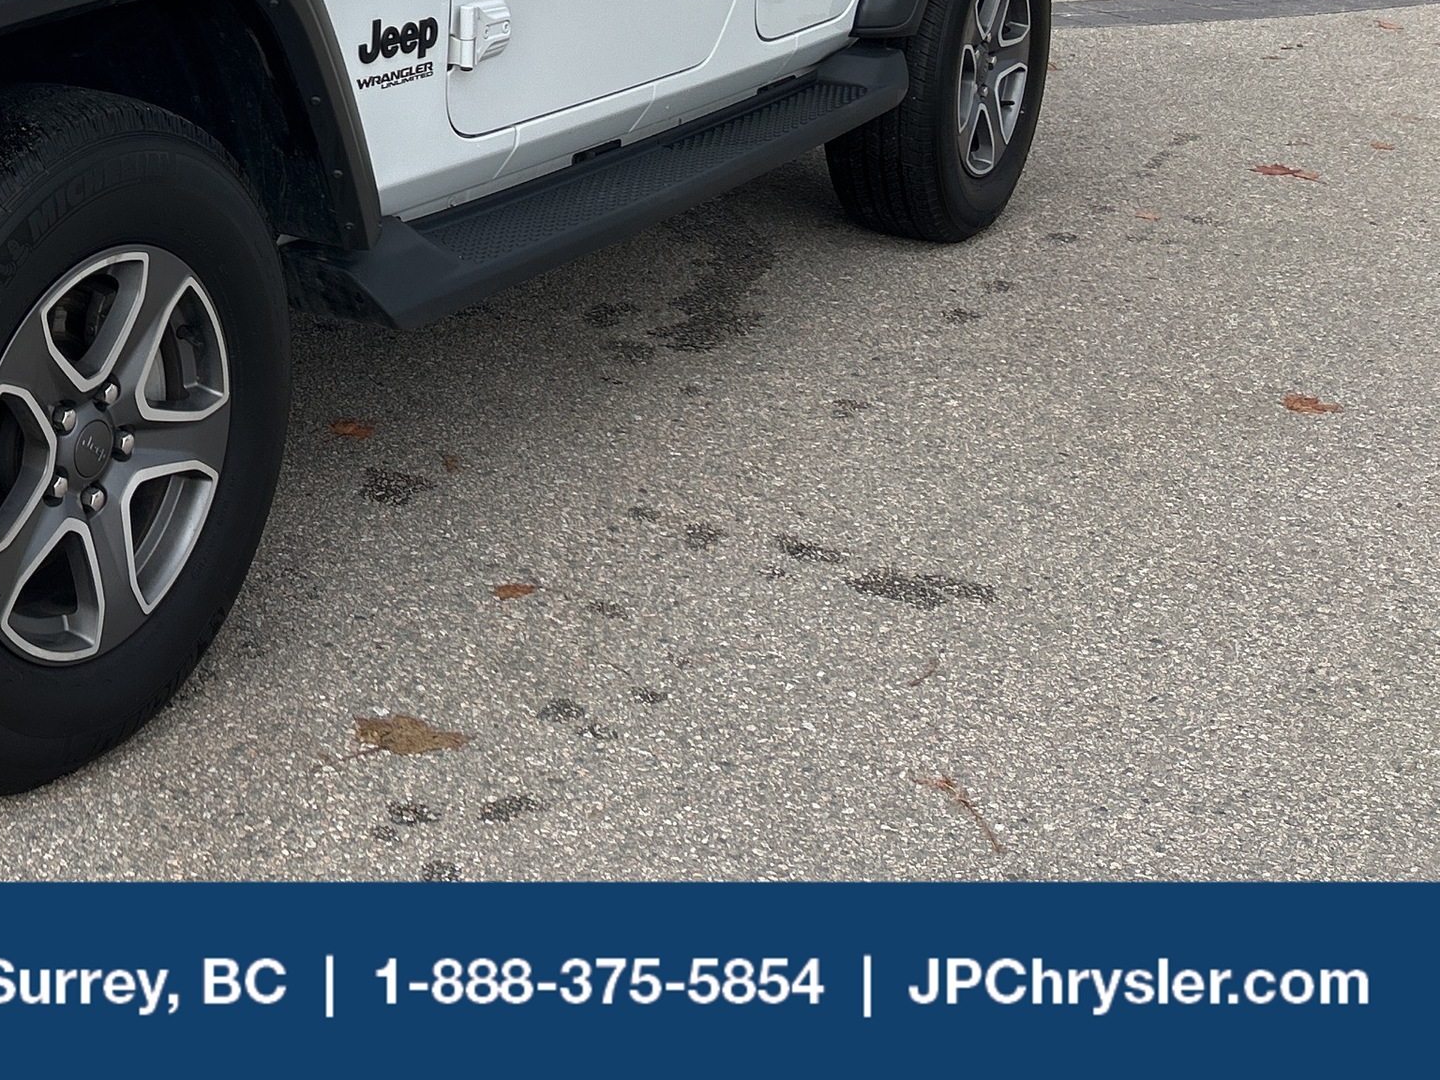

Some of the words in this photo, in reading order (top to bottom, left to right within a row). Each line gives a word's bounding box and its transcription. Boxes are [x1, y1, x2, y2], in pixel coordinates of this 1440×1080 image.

[358, 16, 439, 64] Jeep
[356, 61, 434, 90] WRANGLER
[381, 71, 434, 90] UNLIMITED
